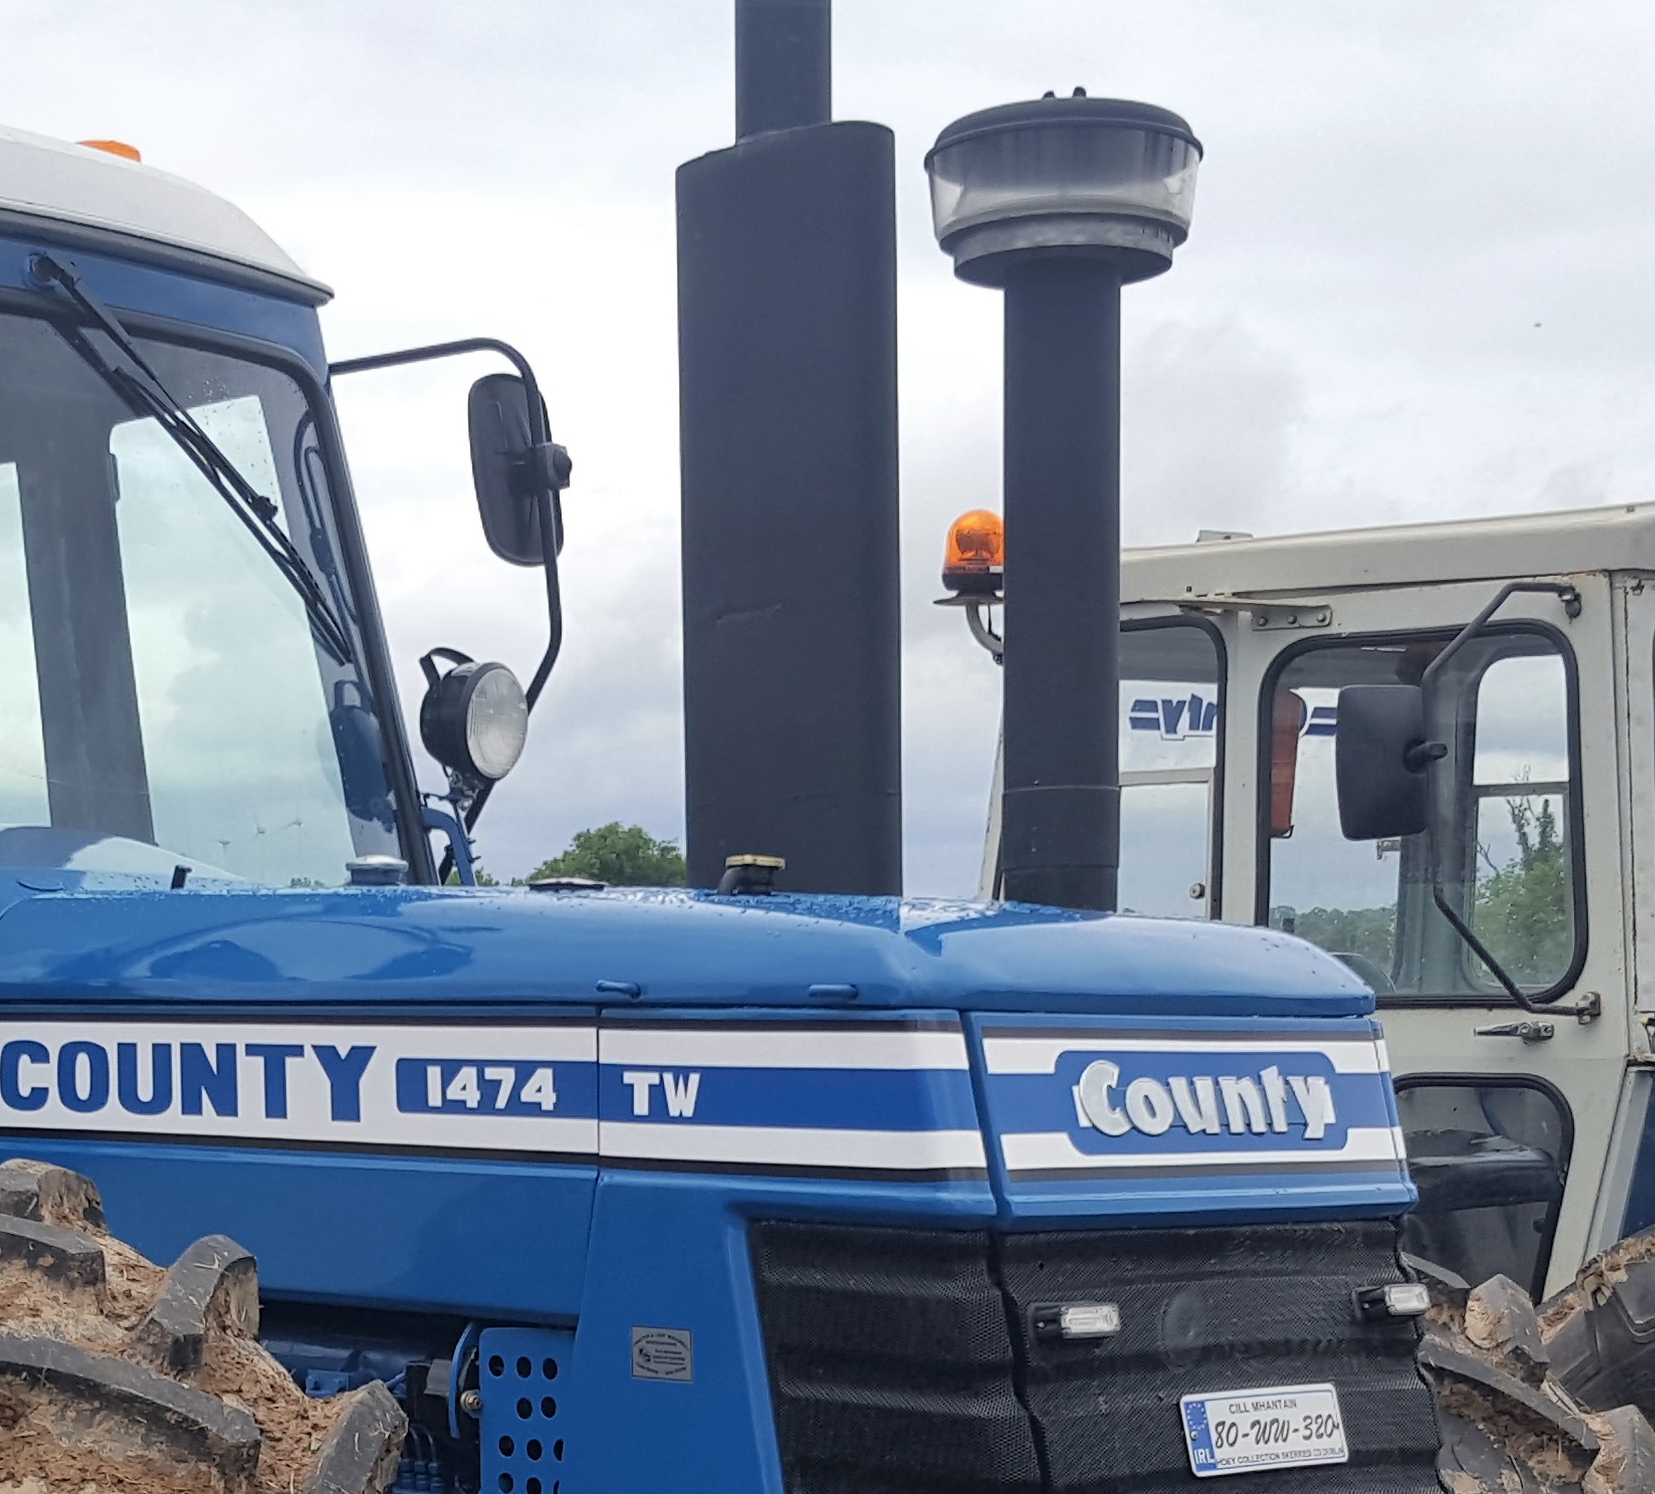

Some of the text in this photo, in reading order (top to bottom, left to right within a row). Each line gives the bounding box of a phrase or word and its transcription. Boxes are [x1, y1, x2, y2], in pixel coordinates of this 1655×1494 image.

[0, 1039, 700, 1123] COUNTY 1474 TW
[1078, 1059, 1329, 1140] County
[1228, 1402, 1250, 1415] CILL
[1194, 1448, 1214, 1464] IRL
